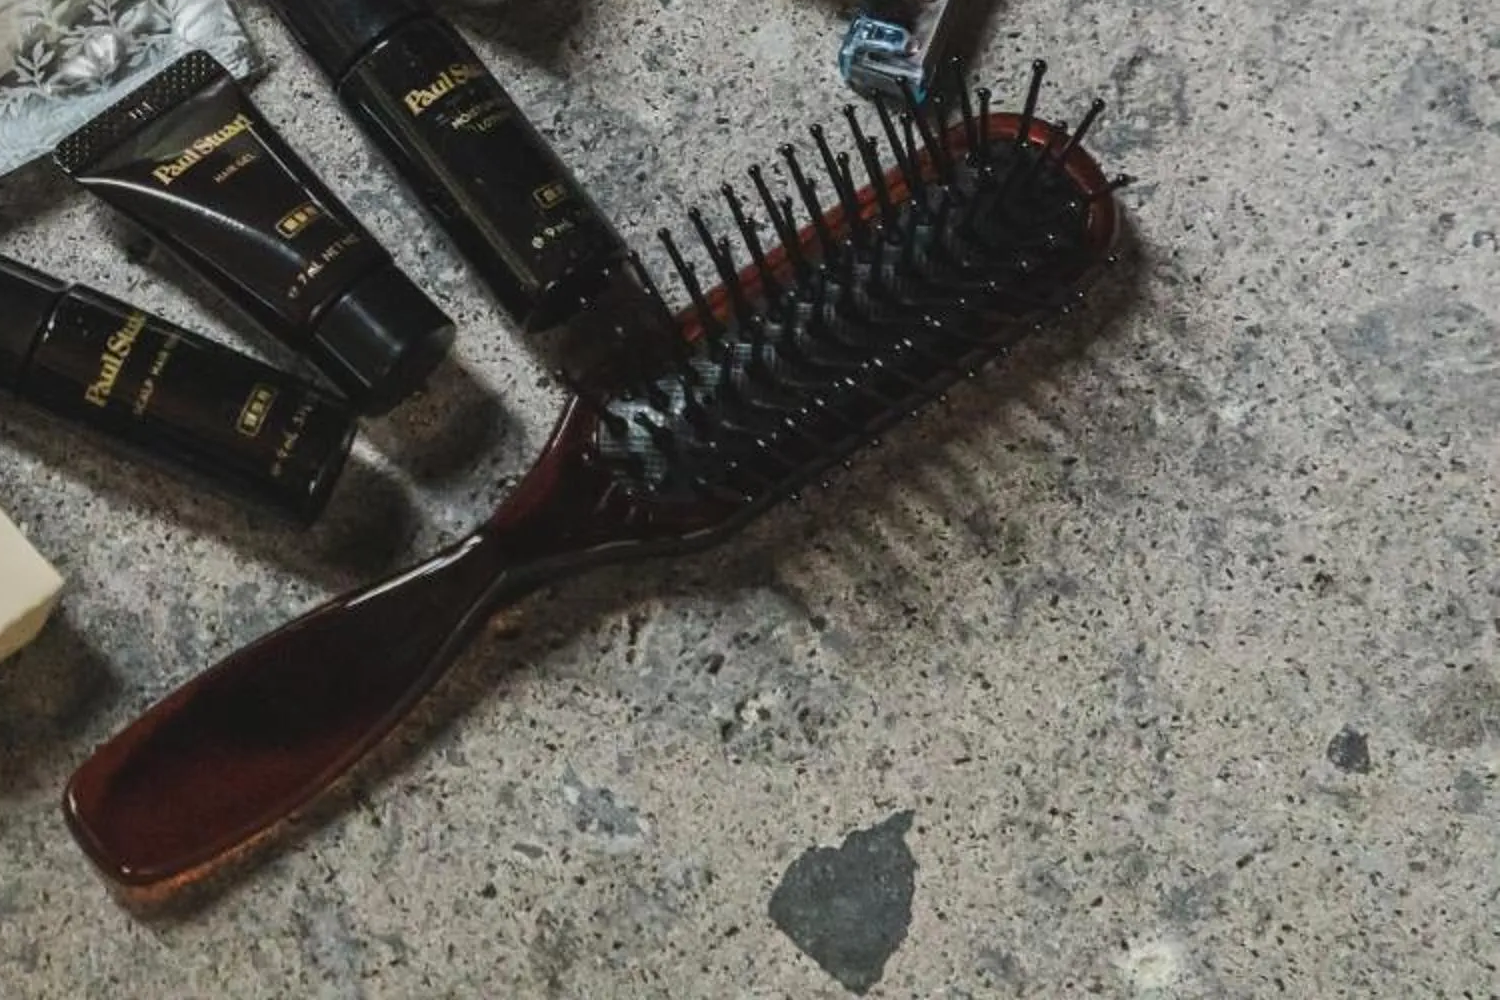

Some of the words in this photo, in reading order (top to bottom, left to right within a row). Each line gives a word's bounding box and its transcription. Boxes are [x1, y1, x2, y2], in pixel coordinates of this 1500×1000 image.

[403, 75, 455, 116] Paul
[152, 145, 198, 185] Paul
[85, 354, 119, 408] Paul
